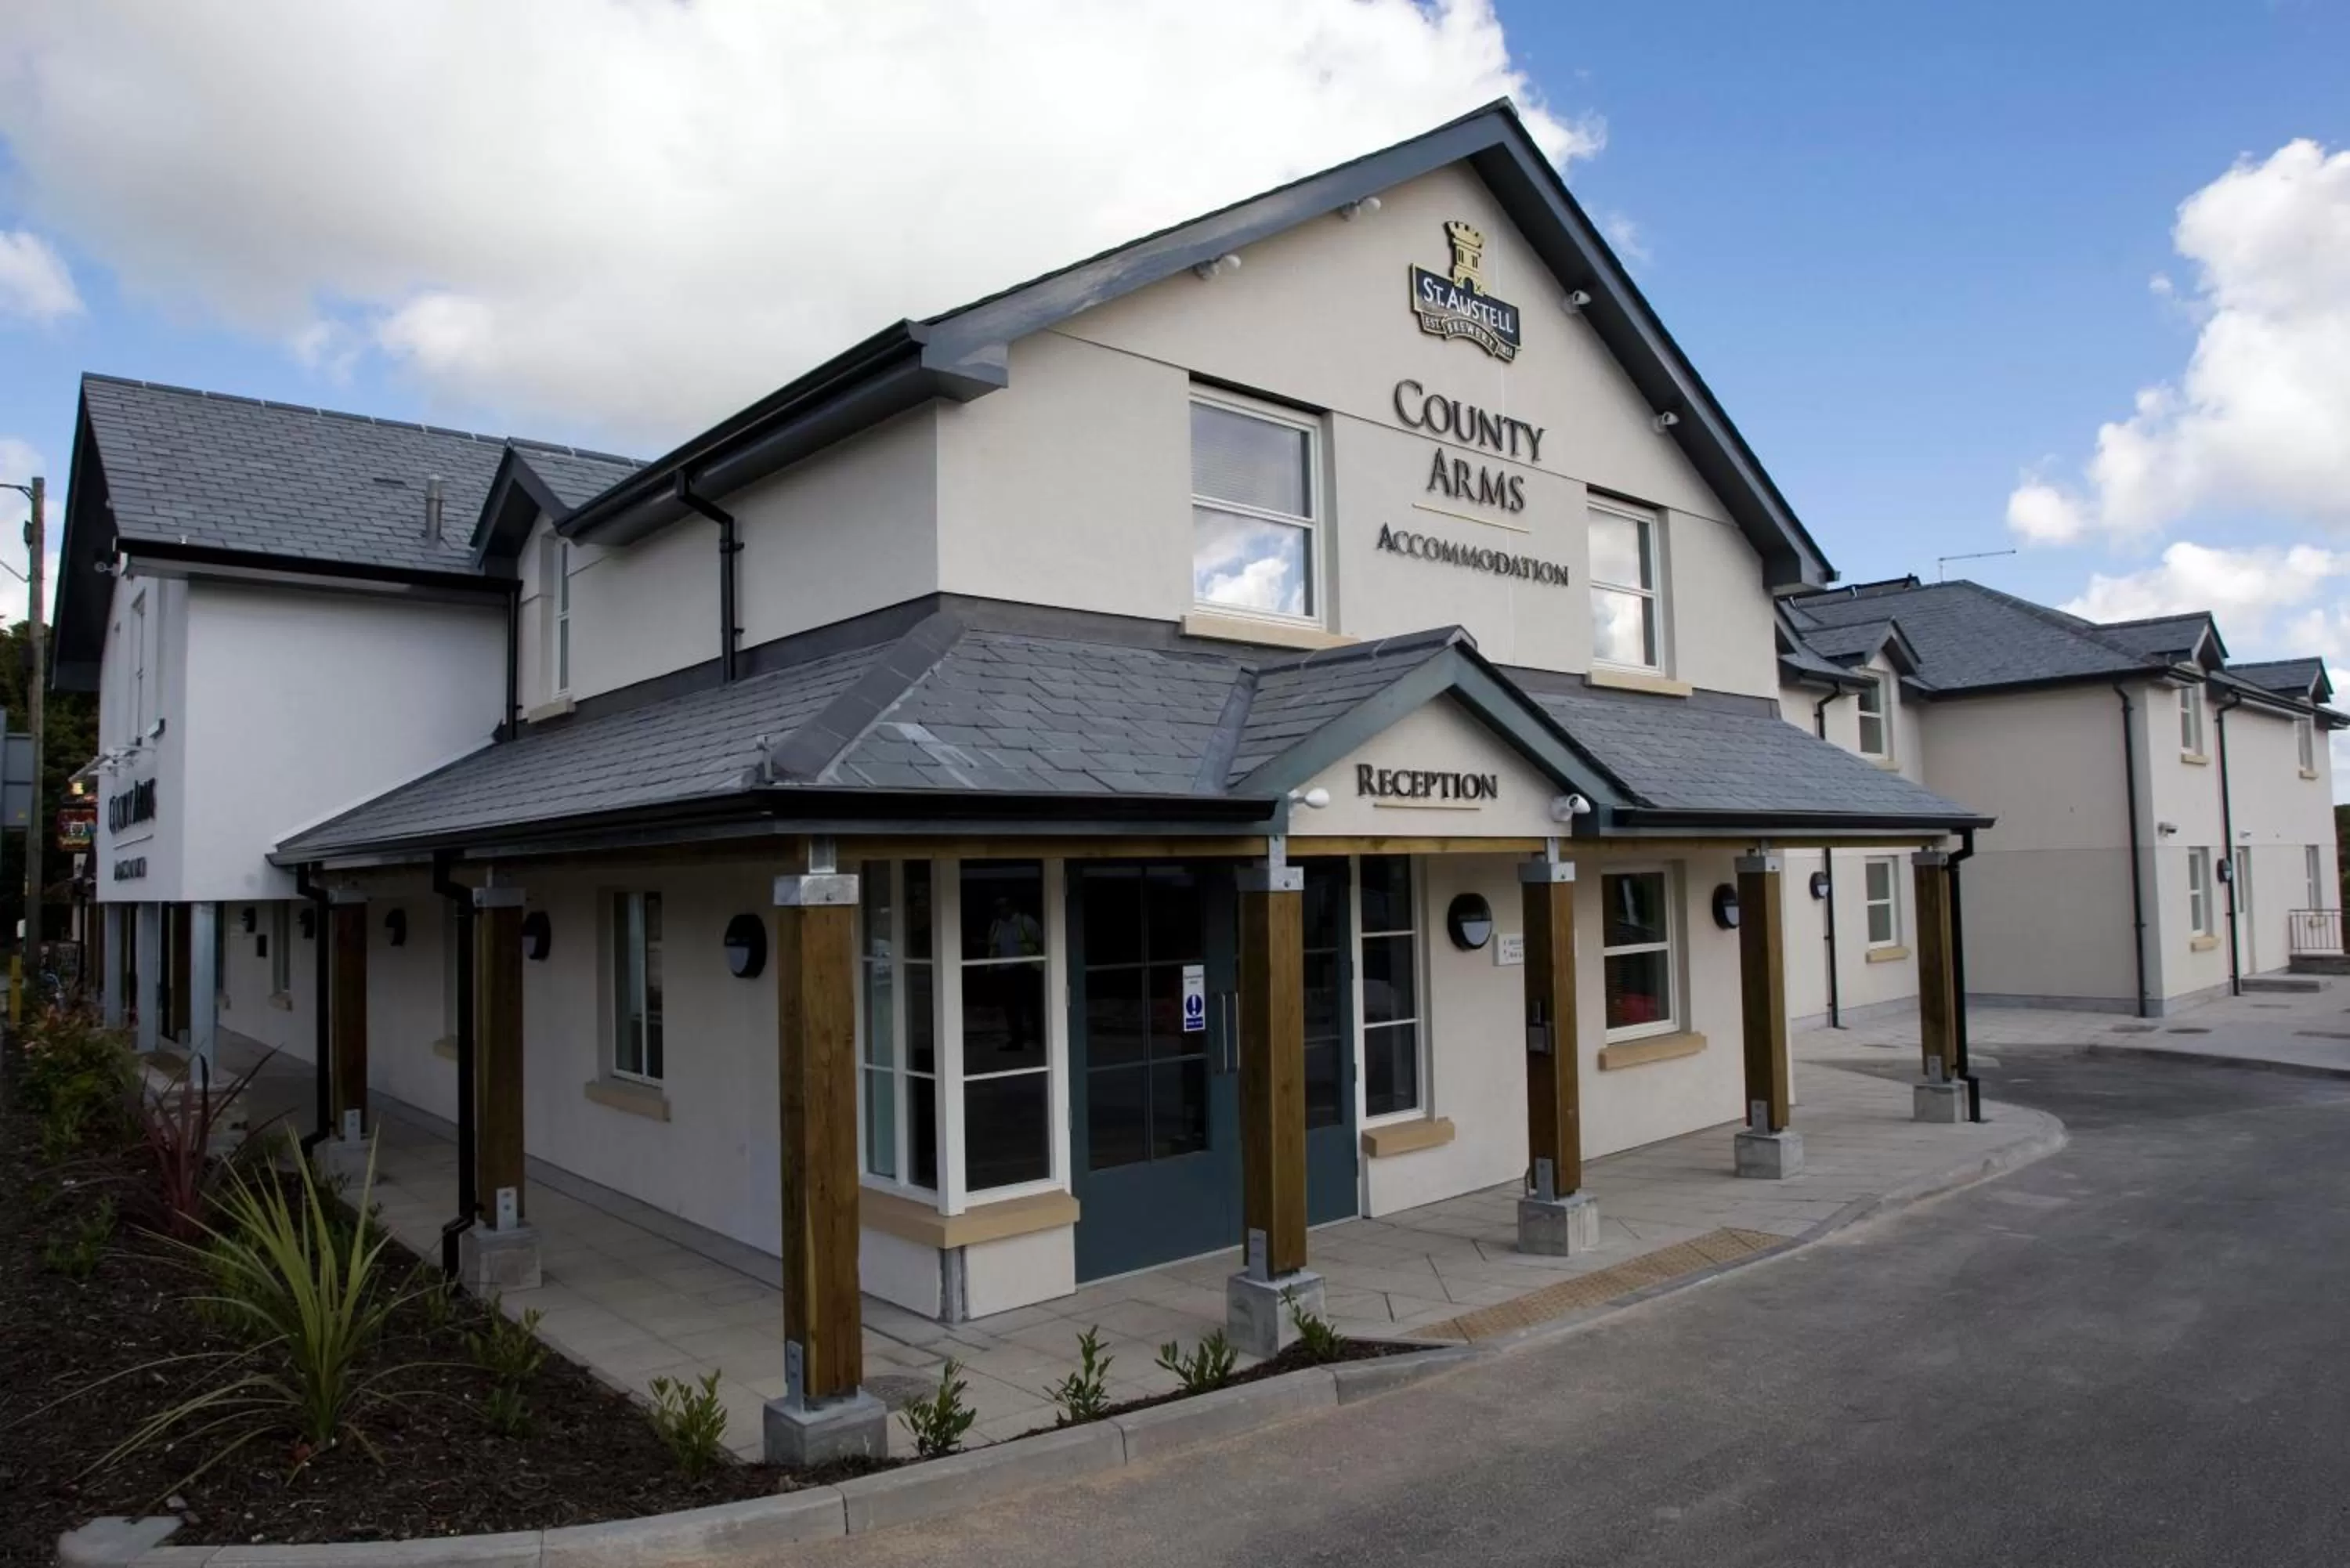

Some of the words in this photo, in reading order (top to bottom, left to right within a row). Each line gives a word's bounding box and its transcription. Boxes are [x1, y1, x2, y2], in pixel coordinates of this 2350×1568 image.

[1445, 287, 1513, 333] AUSTELL
[1394, 379, 1546, 463] COUNTY
[1426, 447, 1525, 514] ARMS
[1377, 521, 1569, 587] ACCOMMODATION
[1356, 764, 1498, 799] RECEPTION
